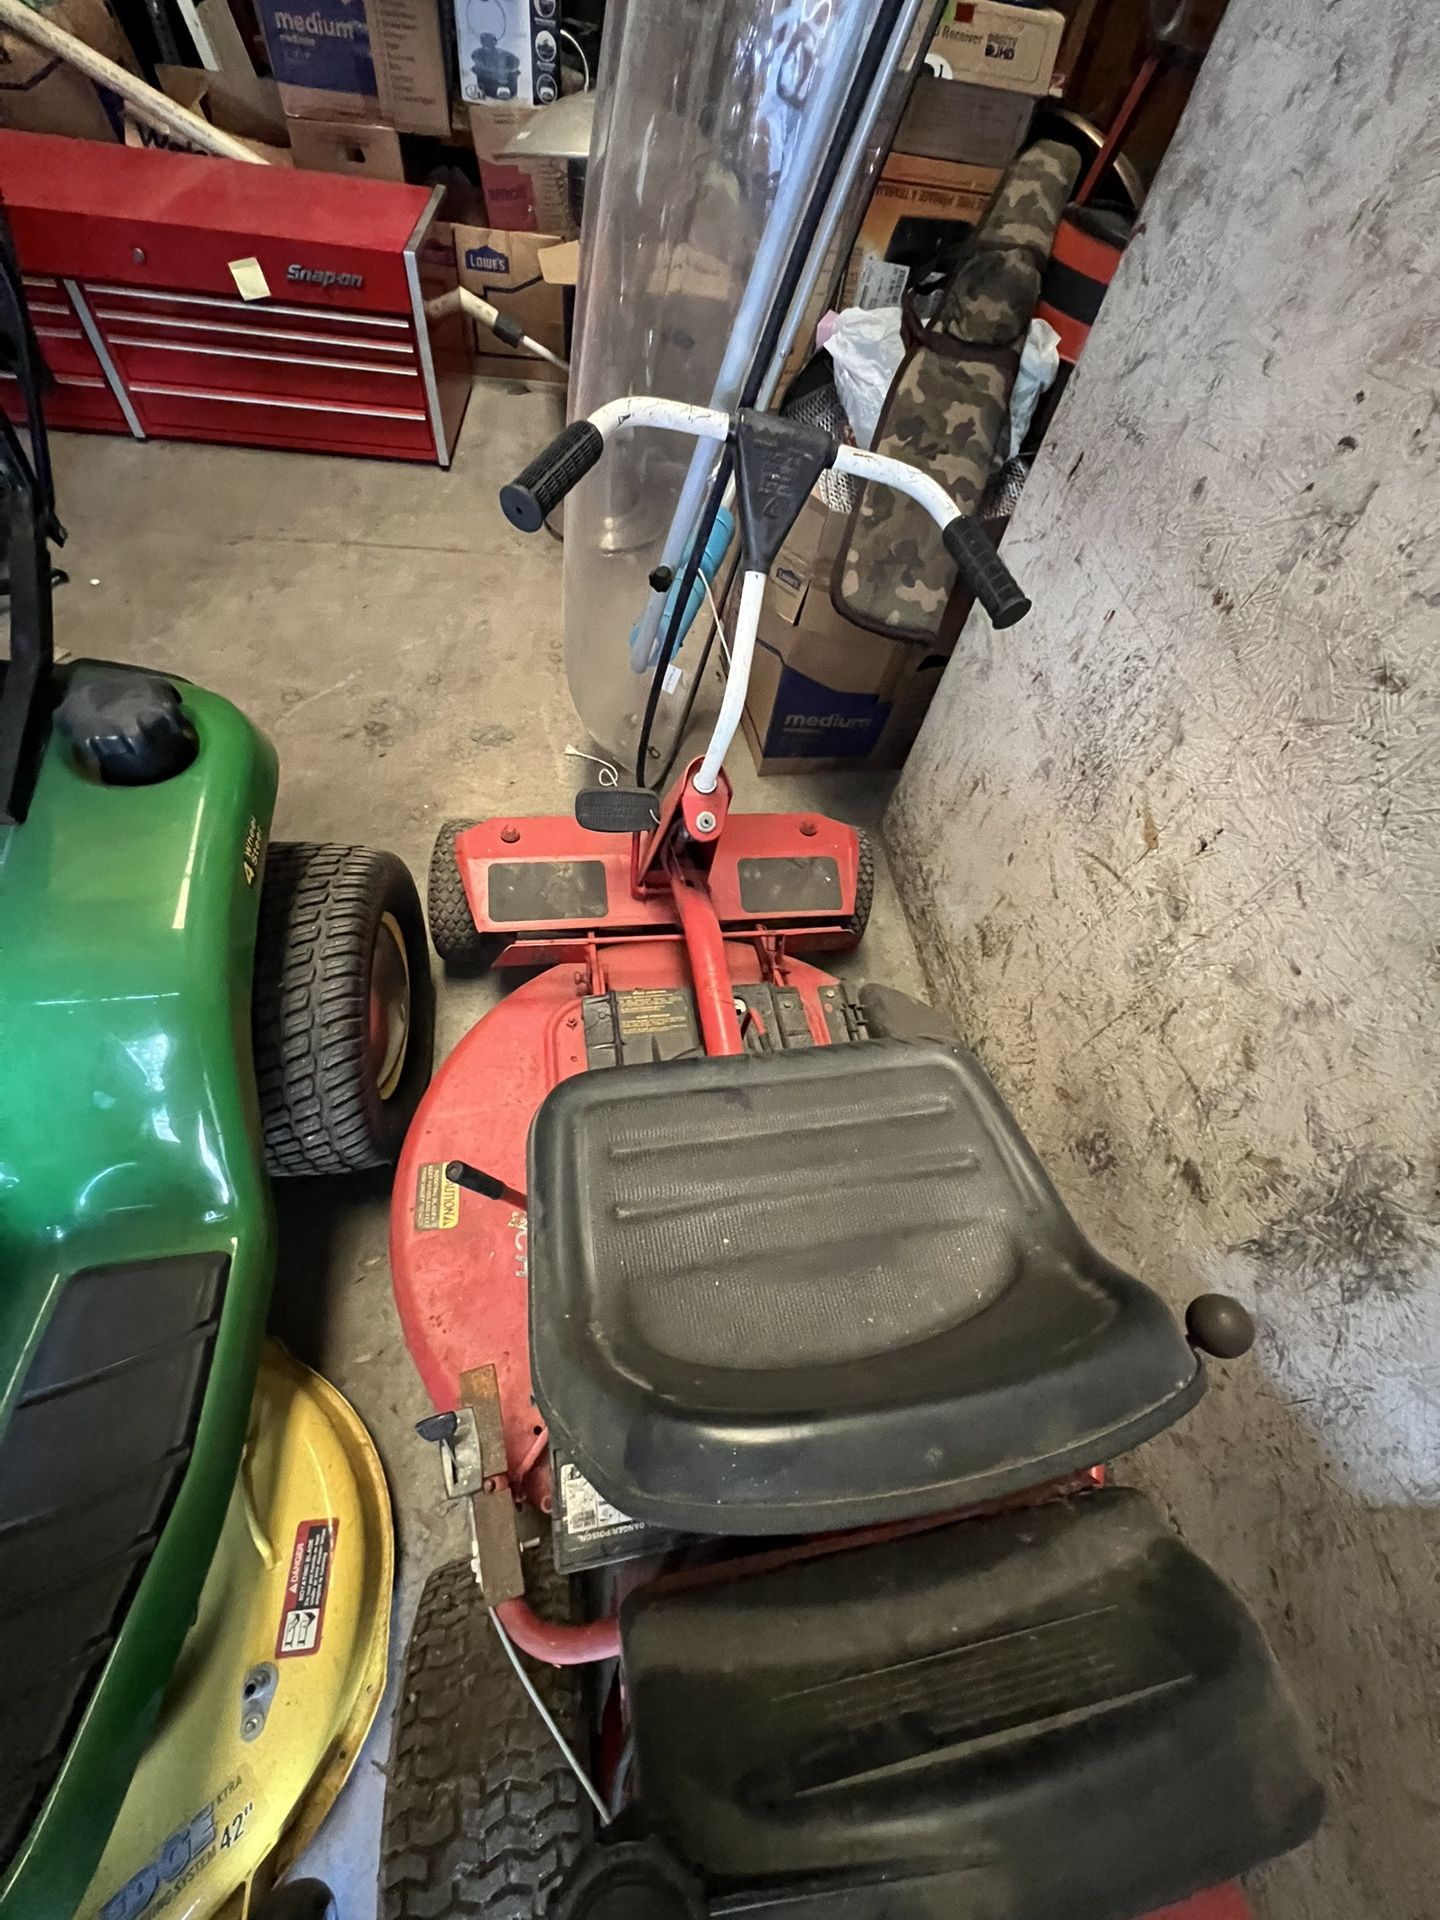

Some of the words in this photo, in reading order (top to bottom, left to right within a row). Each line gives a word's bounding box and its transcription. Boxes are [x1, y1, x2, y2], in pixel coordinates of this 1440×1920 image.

[274, 11, 354, 39] medium
[942, 25, 983, 45] Receiver
[469, 253, 506, 271] LOWE'S
[783, 713, 872, 728] medium
[244, 814, 257, 857] Wheel
[250, 825, 262, 866] Steer
[243, 861, 255, 885] 4
[443, 1180, 455, 1215] AUTION
[291, 1542, 304, 1583] DANGER
[173, 1845, 217, 1893] SYSTEM
[220, 1801, 254, 1850] 42"
